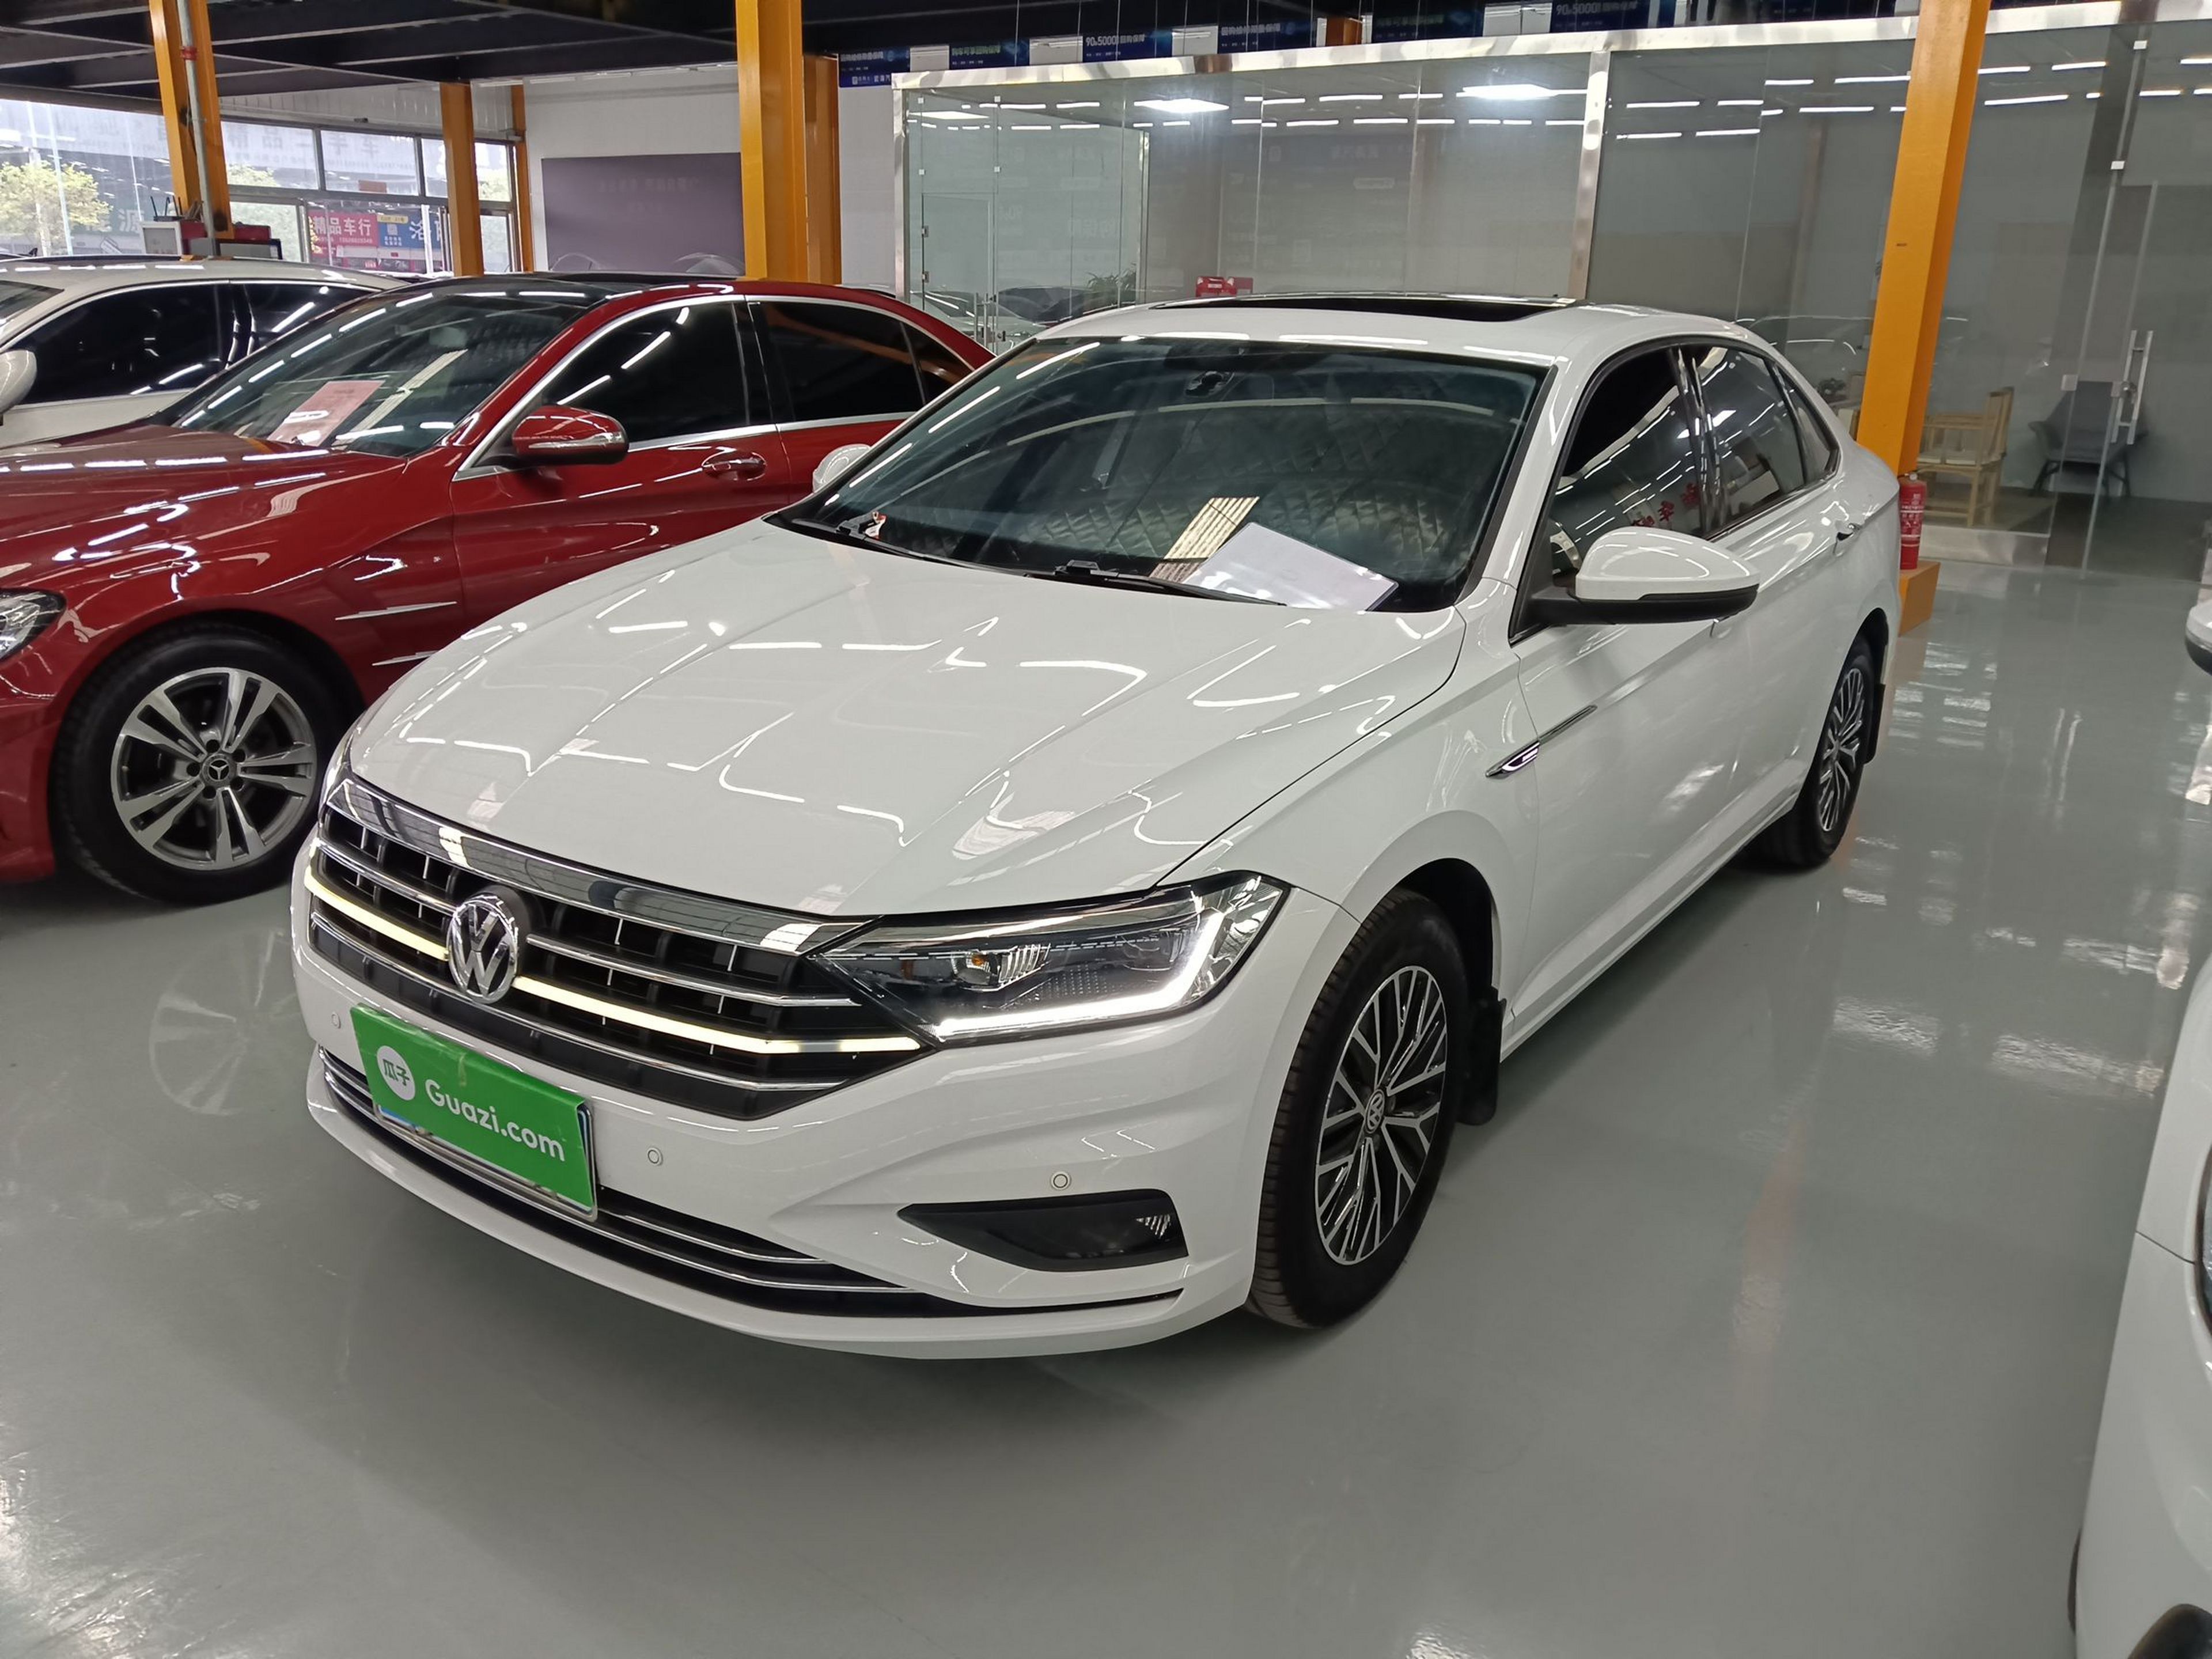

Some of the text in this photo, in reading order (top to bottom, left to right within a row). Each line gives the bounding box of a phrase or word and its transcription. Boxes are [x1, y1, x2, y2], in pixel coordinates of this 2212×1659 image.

[314, 215, 372, 237] 精品车行
[382, 1058, 411, 1086] 瓜子
[425, 1078, 565, 1162] Guazi.com
